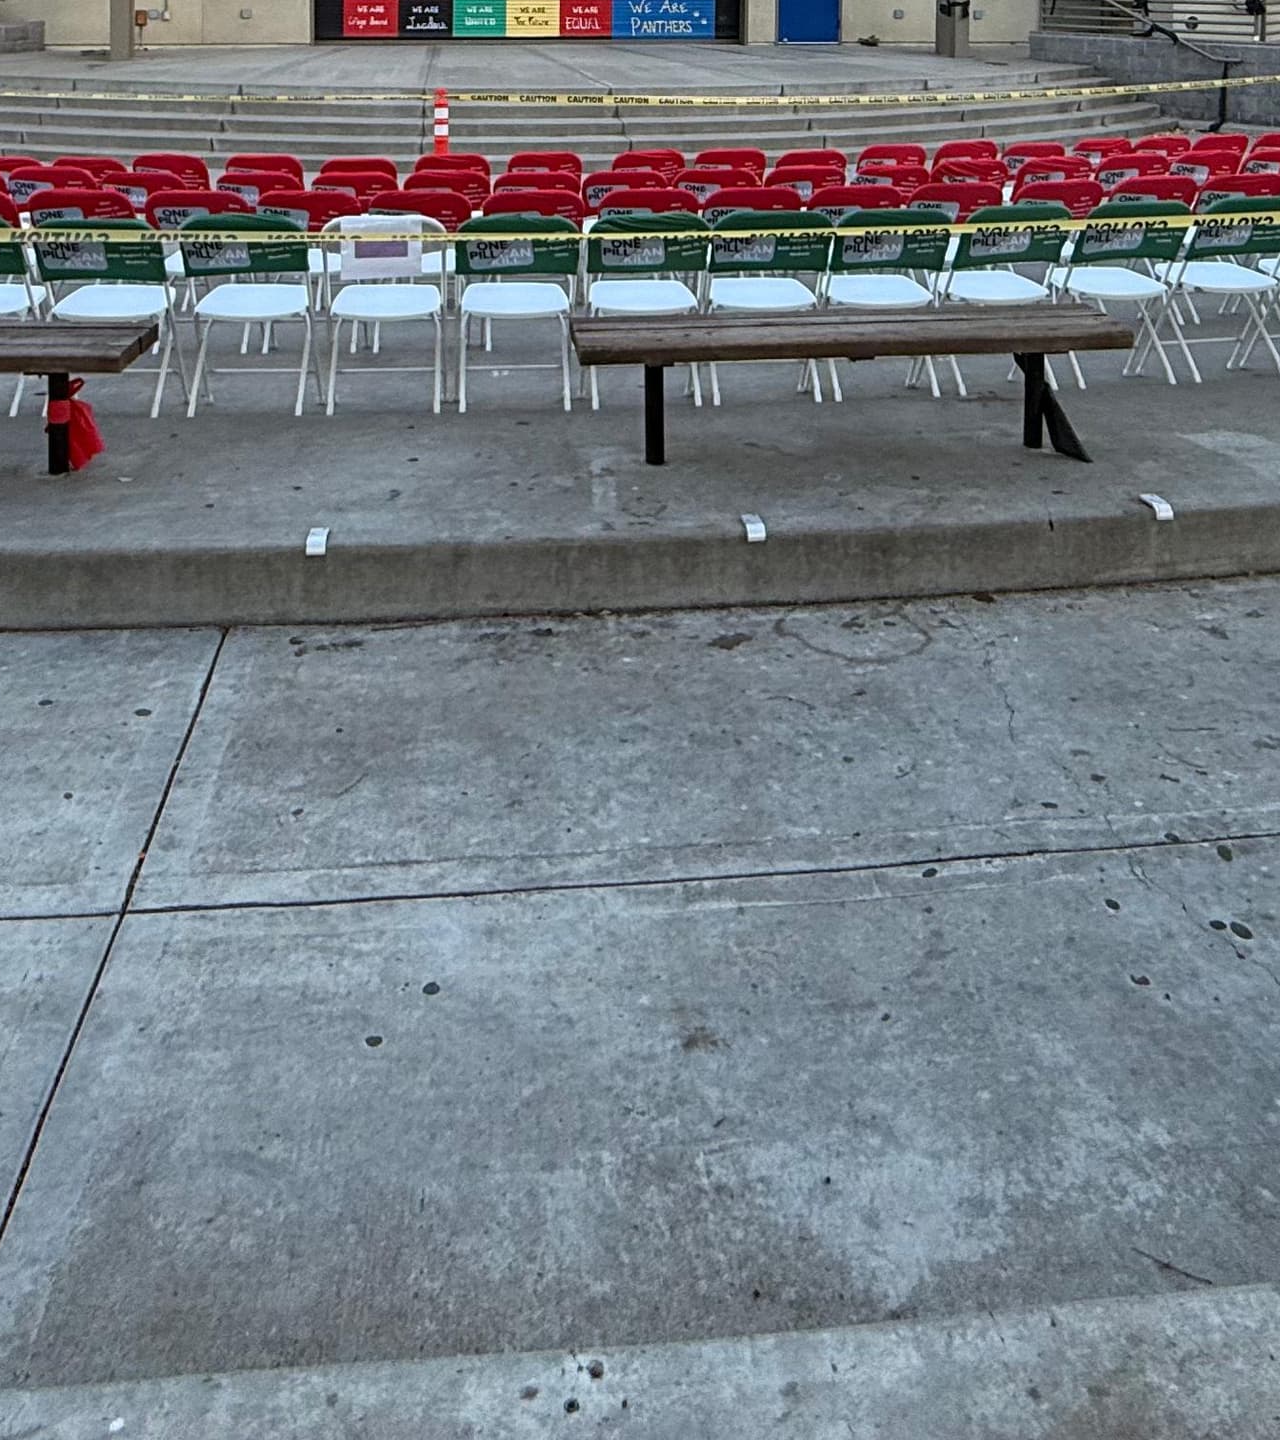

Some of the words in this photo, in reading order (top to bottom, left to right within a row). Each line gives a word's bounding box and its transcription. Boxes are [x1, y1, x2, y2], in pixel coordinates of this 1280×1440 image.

[565, 17, 601, 30] EQUAL
[630, 17, 693, 36] PANTHERS
[471, 94, 509, 102] CAUTION
[519, 95, 557, 103] CAUTION
[567, 96, 604, 104] CAUTION
[613, 96, 649, 105] CAUTION
[658, 97, 694, 105] CAUTION
[39, 210, 64, 219] ONE
[162, 209, 190, 218] ONE
[610, 240, 641, 249] ONE
[854, 235, 883, 245] ONE
[48, 242, 81, 252] ONE
[476, 240, 509, 251] ONE
[470, 250, 497, 261] PILL
[603, 247, 628, 257] PILL
